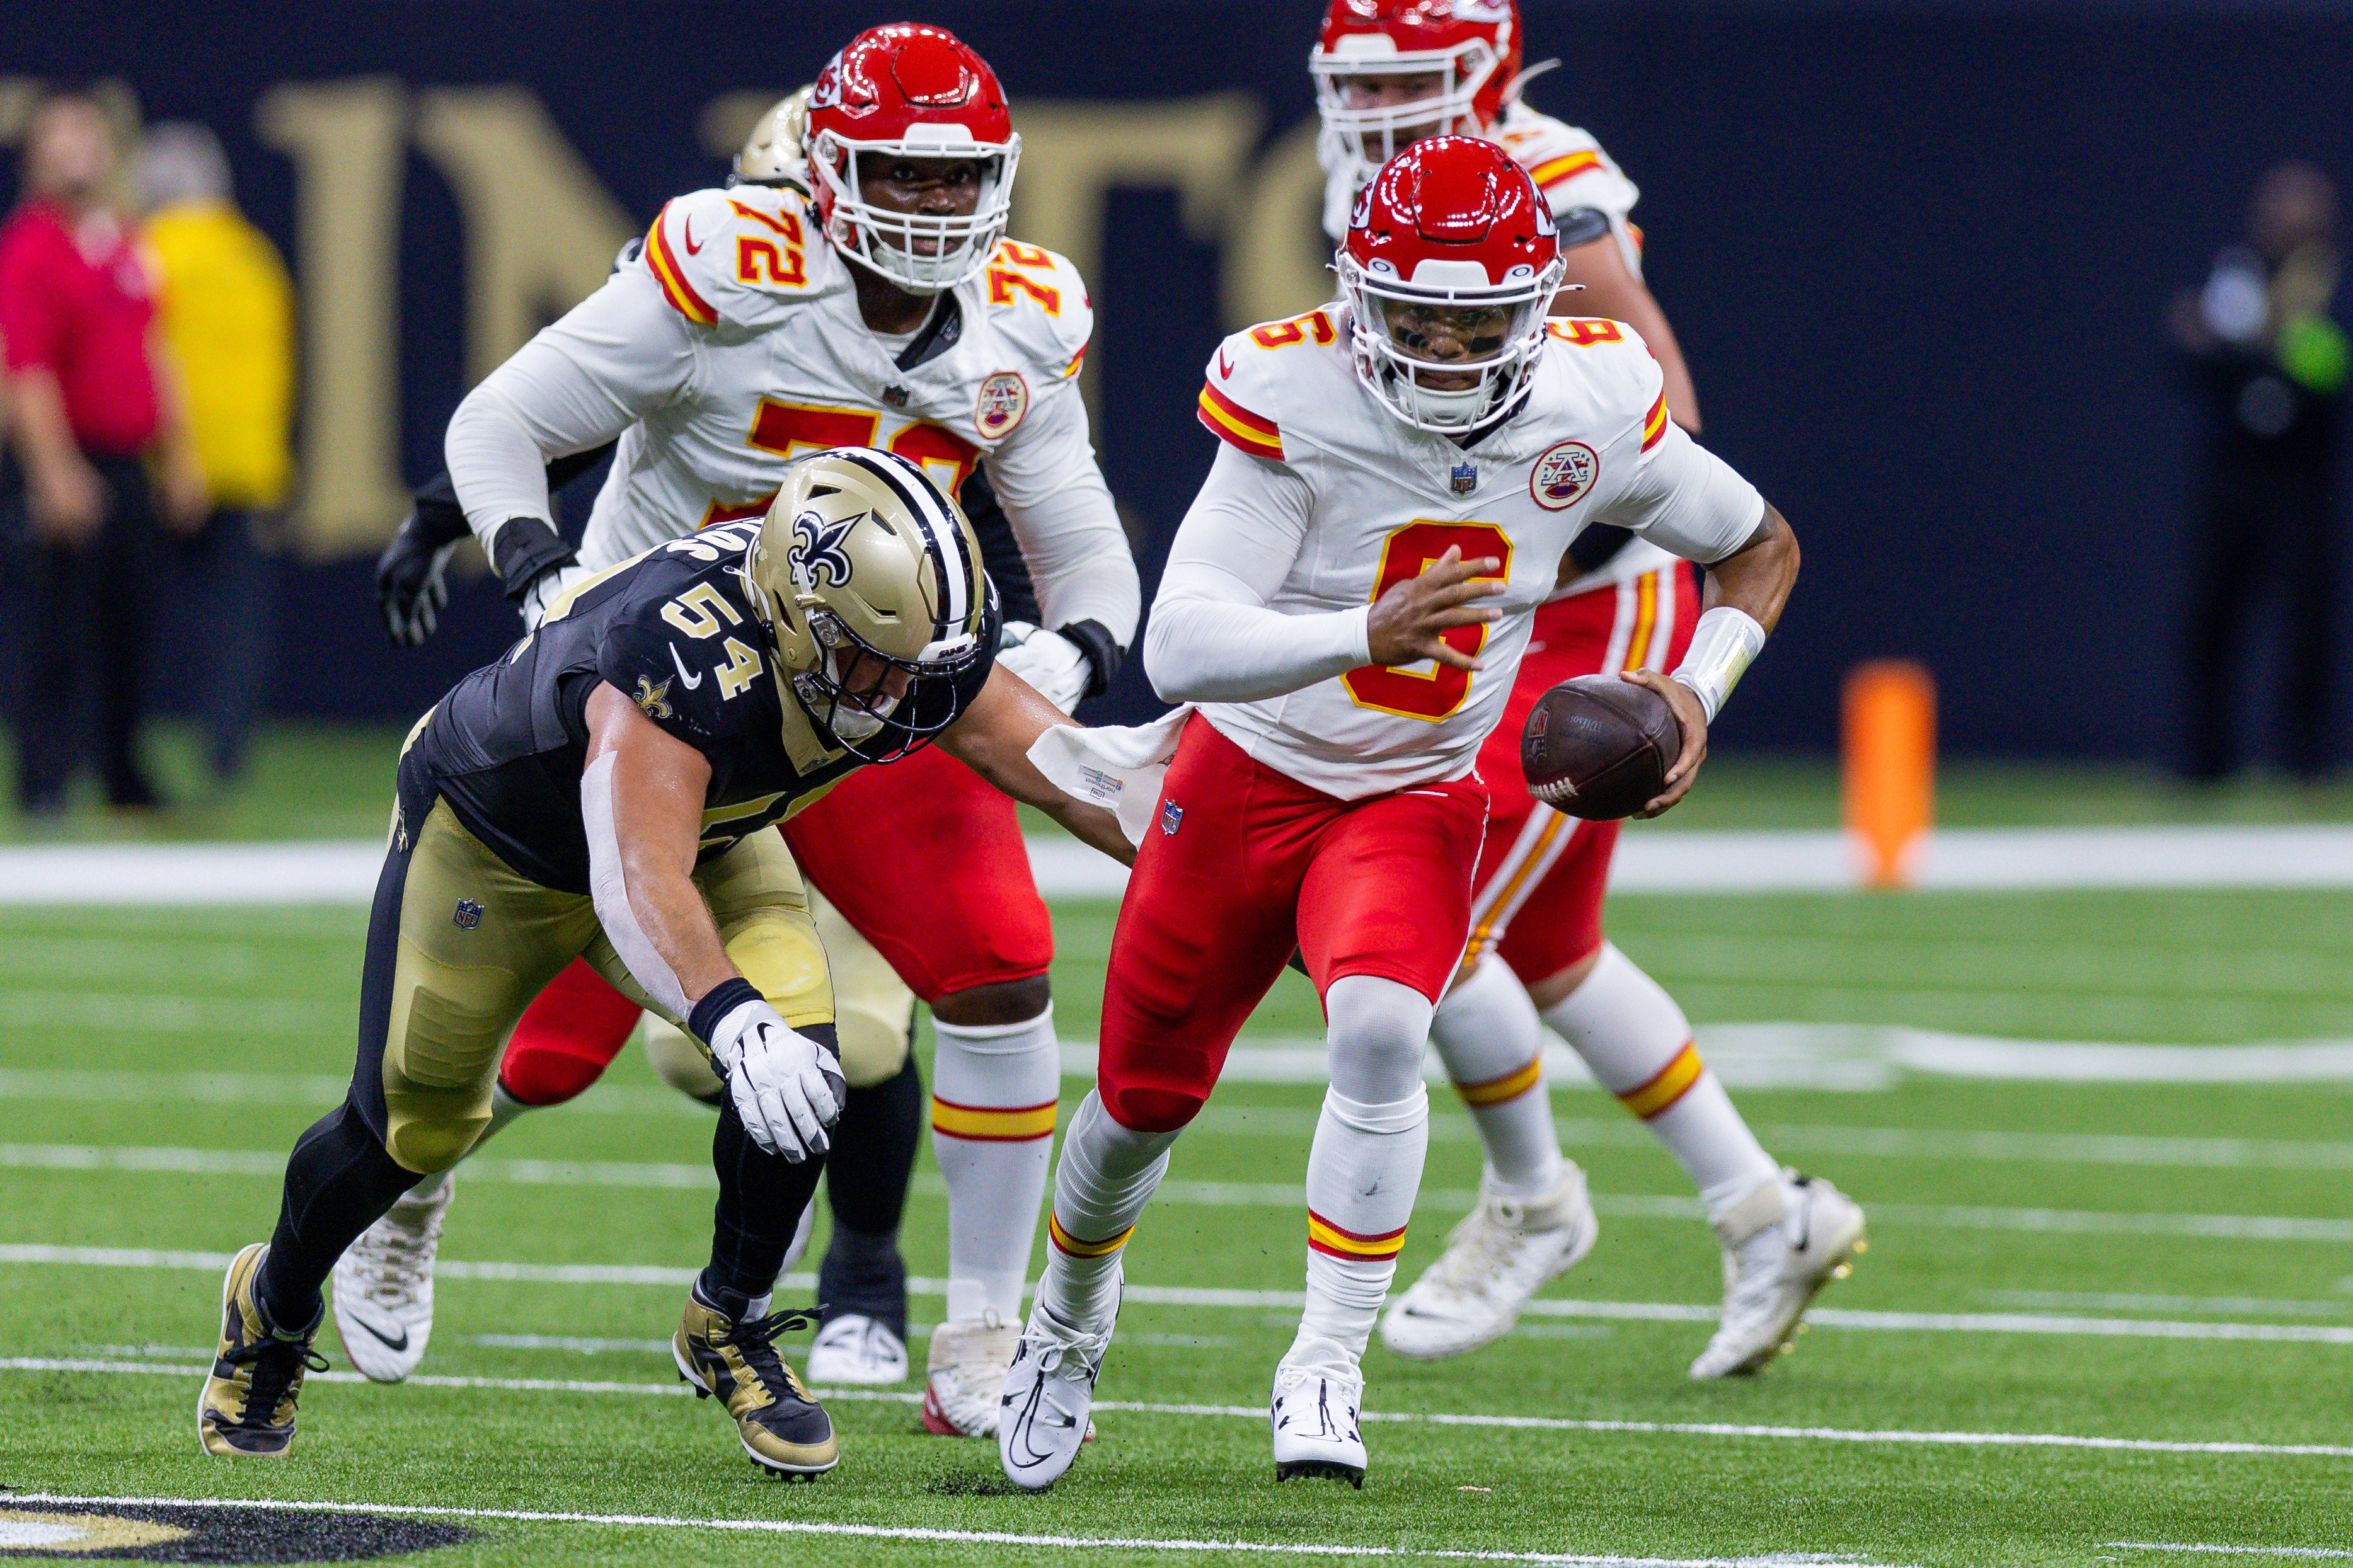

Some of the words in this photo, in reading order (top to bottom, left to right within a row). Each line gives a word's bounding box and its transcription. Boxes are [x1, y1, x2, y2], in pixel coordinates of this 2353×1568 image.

[726, 198, 809, 289] 72
[986, 236, 1061, 318] 72
[1247, 309, 1338, 351] 6
[1547, 318, 1625, 348] 6
[660, 581, 764, 701] 54
[1339, 518, 1515, 723] 6
